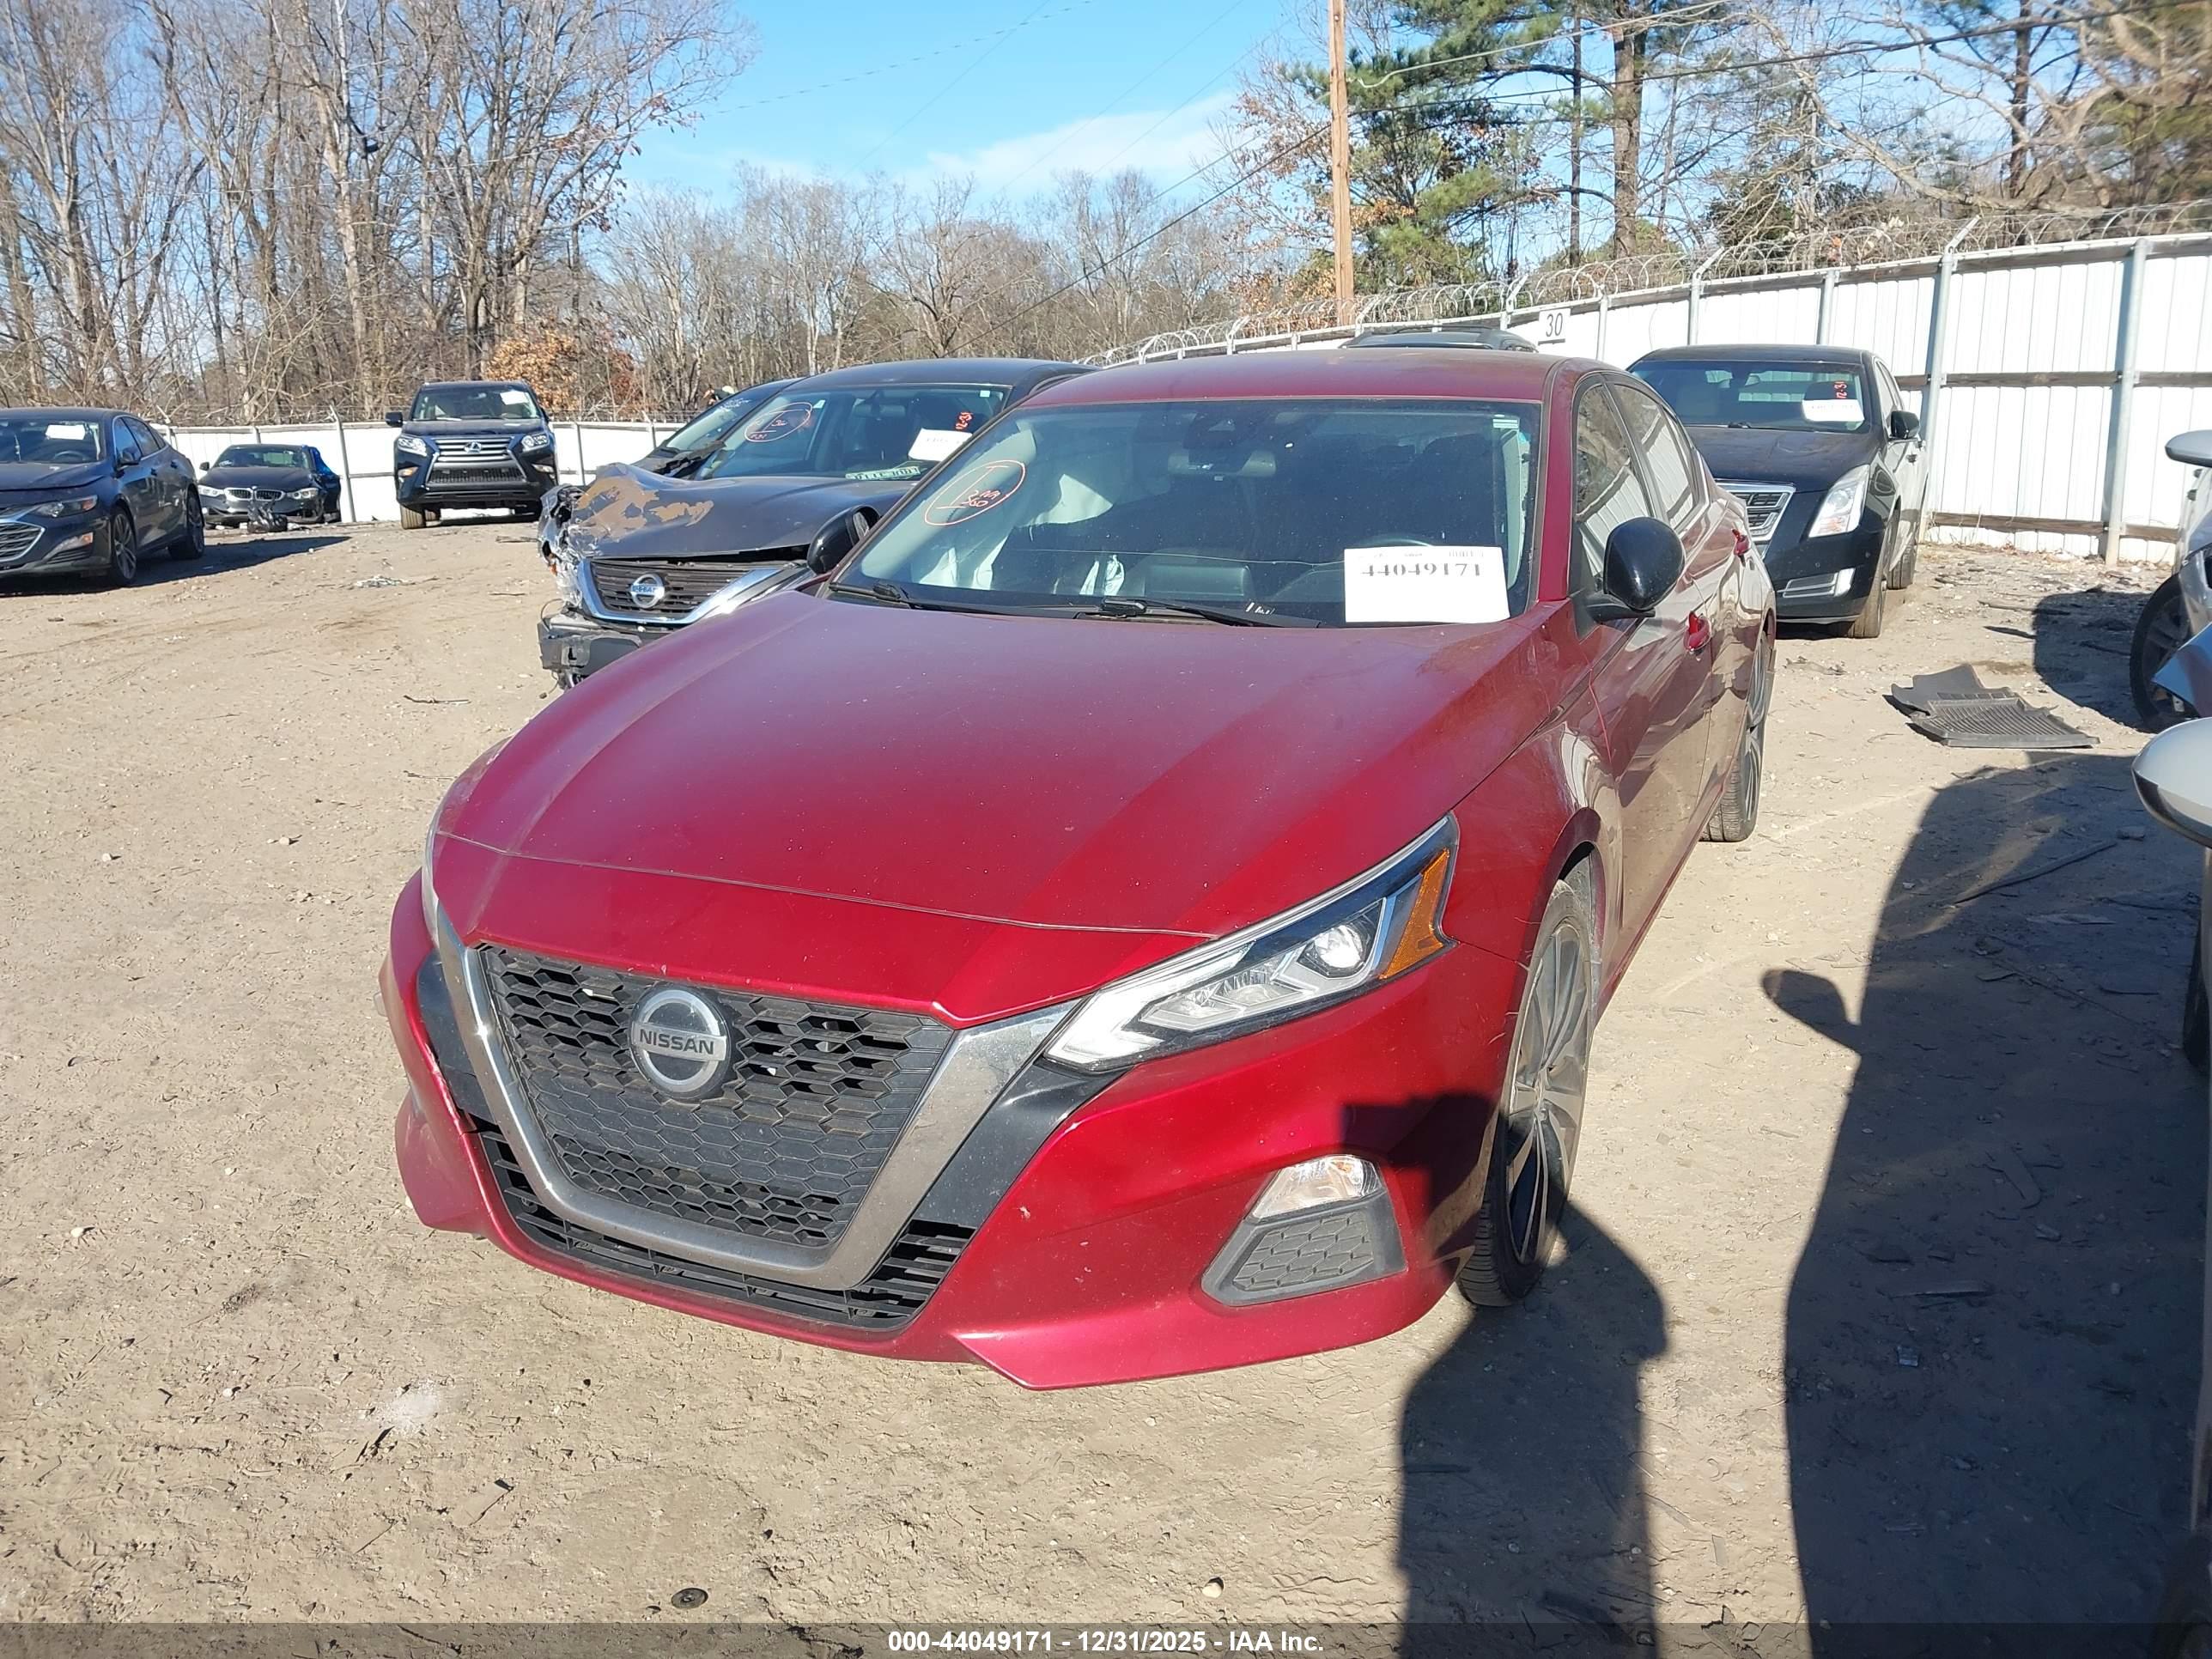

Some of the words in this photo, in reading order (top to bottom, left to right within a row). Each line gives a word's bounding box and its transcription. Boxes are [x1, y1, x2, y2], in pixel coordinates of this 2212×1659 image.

[1546, 313, 1563, 337] 30
[1361, 562, 1481, 577] 44049171
[639, 1029, 714, 1055] NISSAN
